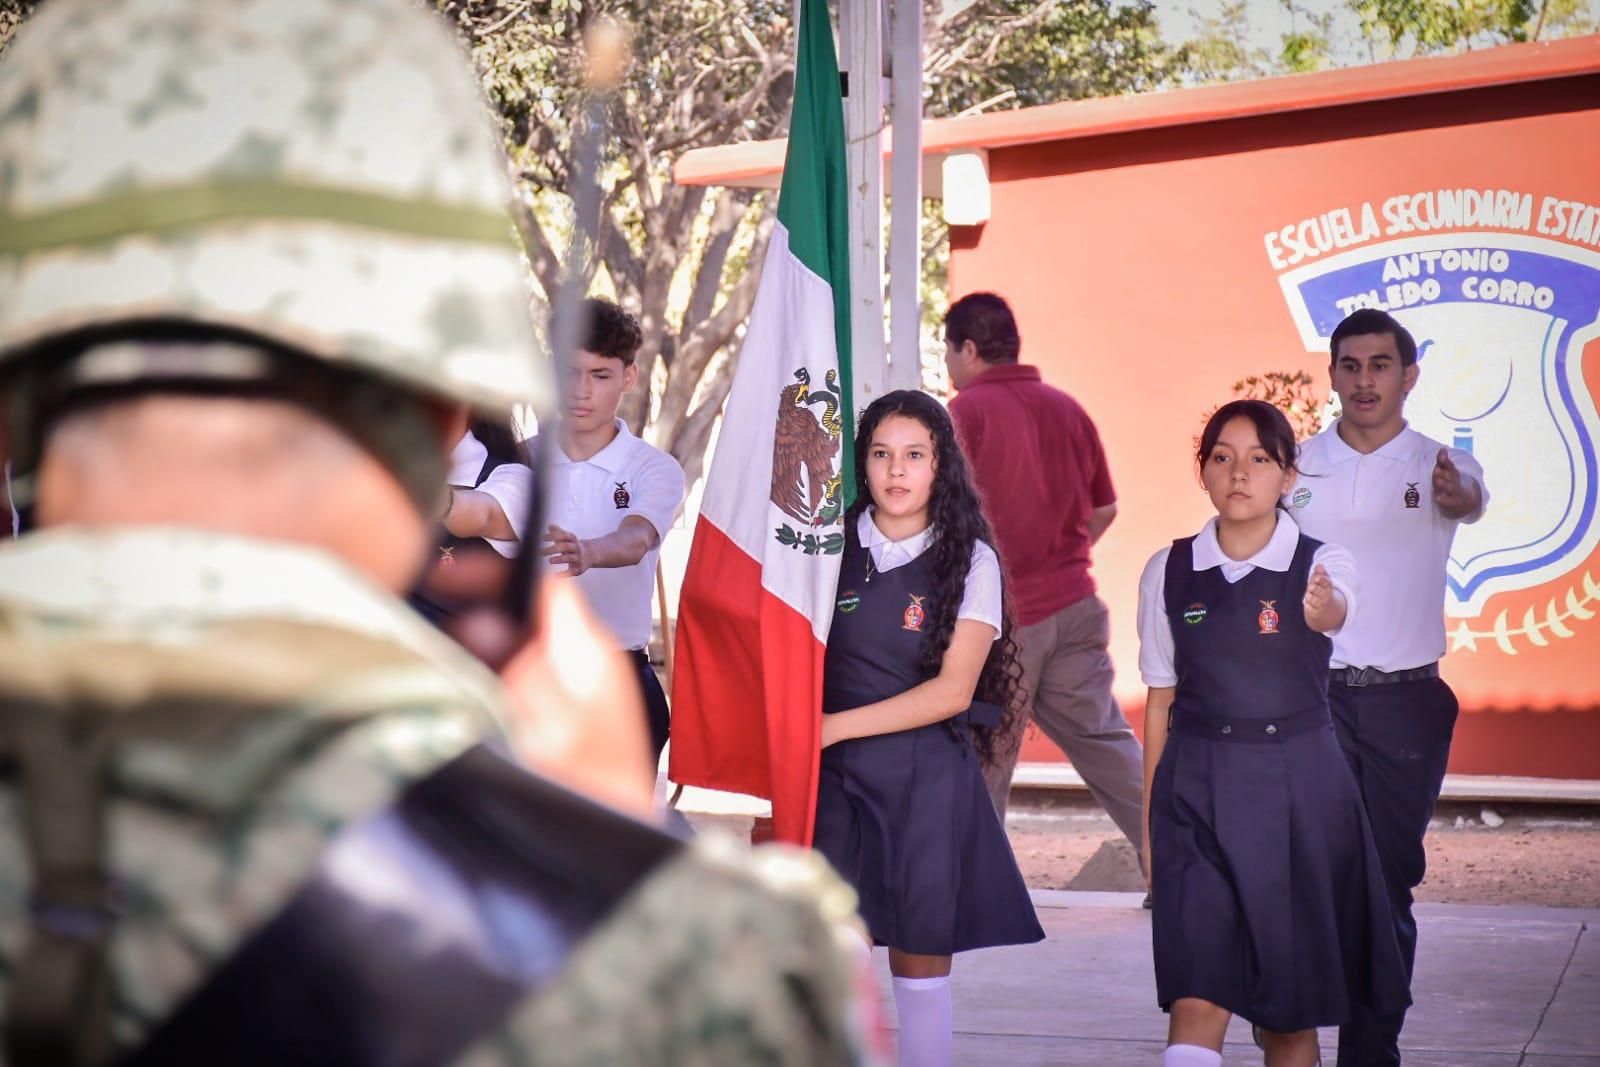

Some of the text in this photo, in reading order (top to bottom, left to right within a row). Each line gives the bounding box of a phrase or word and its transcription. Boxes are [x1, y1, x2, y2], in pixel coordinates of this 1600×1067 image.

[1264, 202, 1380, 270] ESCUELA
[1382, 188, 1532, 236] SECUNDARIA
[1382, 249, 1509, 283] ANTONIO
[1461, 276, 1554, 310] CORRO
